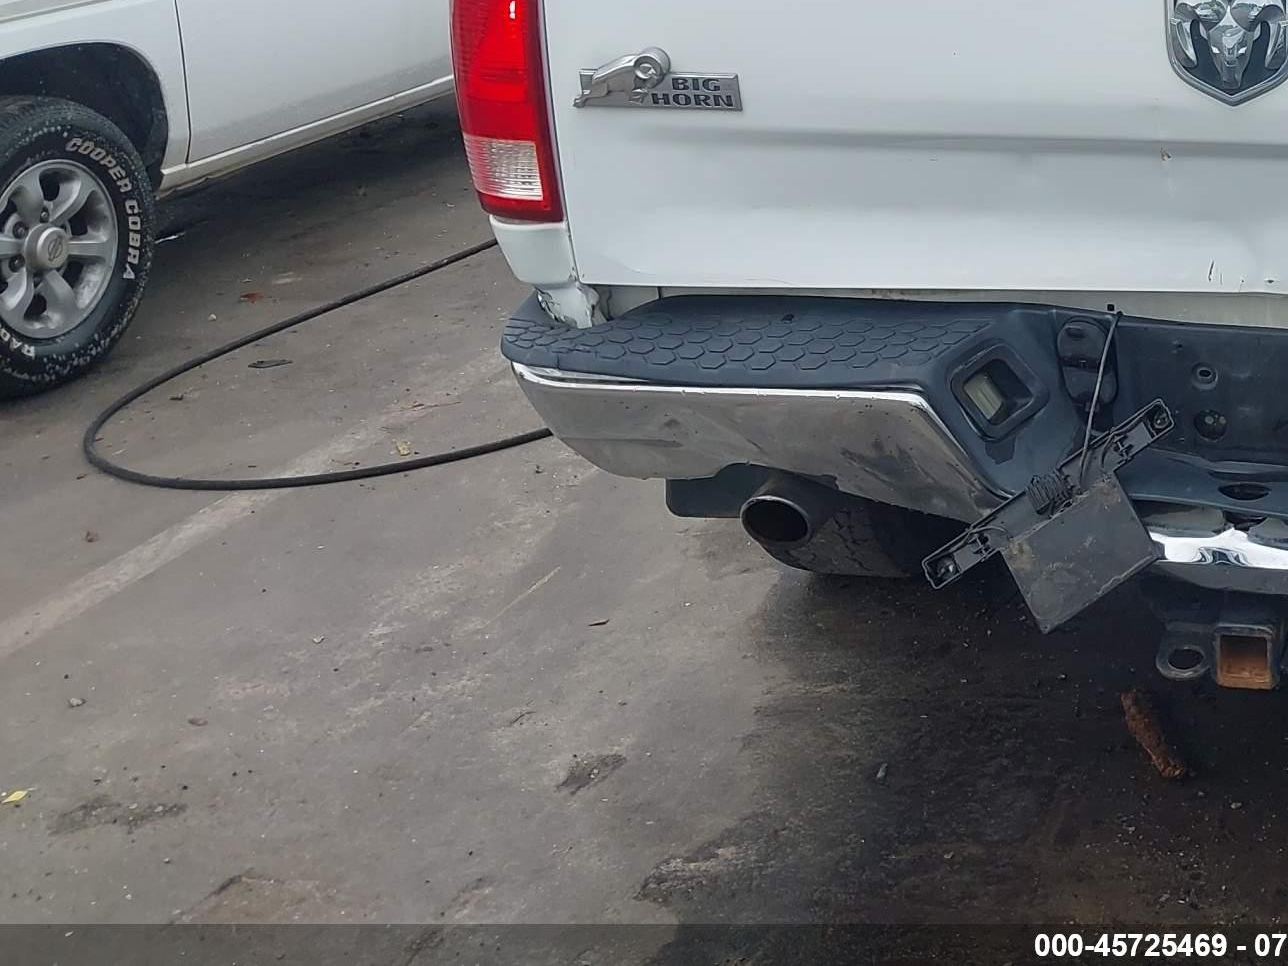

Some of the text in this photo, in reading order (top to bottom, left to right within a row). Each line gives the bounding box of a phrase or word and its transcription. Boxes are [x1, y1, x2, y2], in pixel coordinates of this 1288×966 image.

[671, 77, 721, 92] BIG
[651, 92, 734, 108] HORN
[65, 137, 142, 280] COOPER COBRA
[0, 324, 36, 360] RAD
